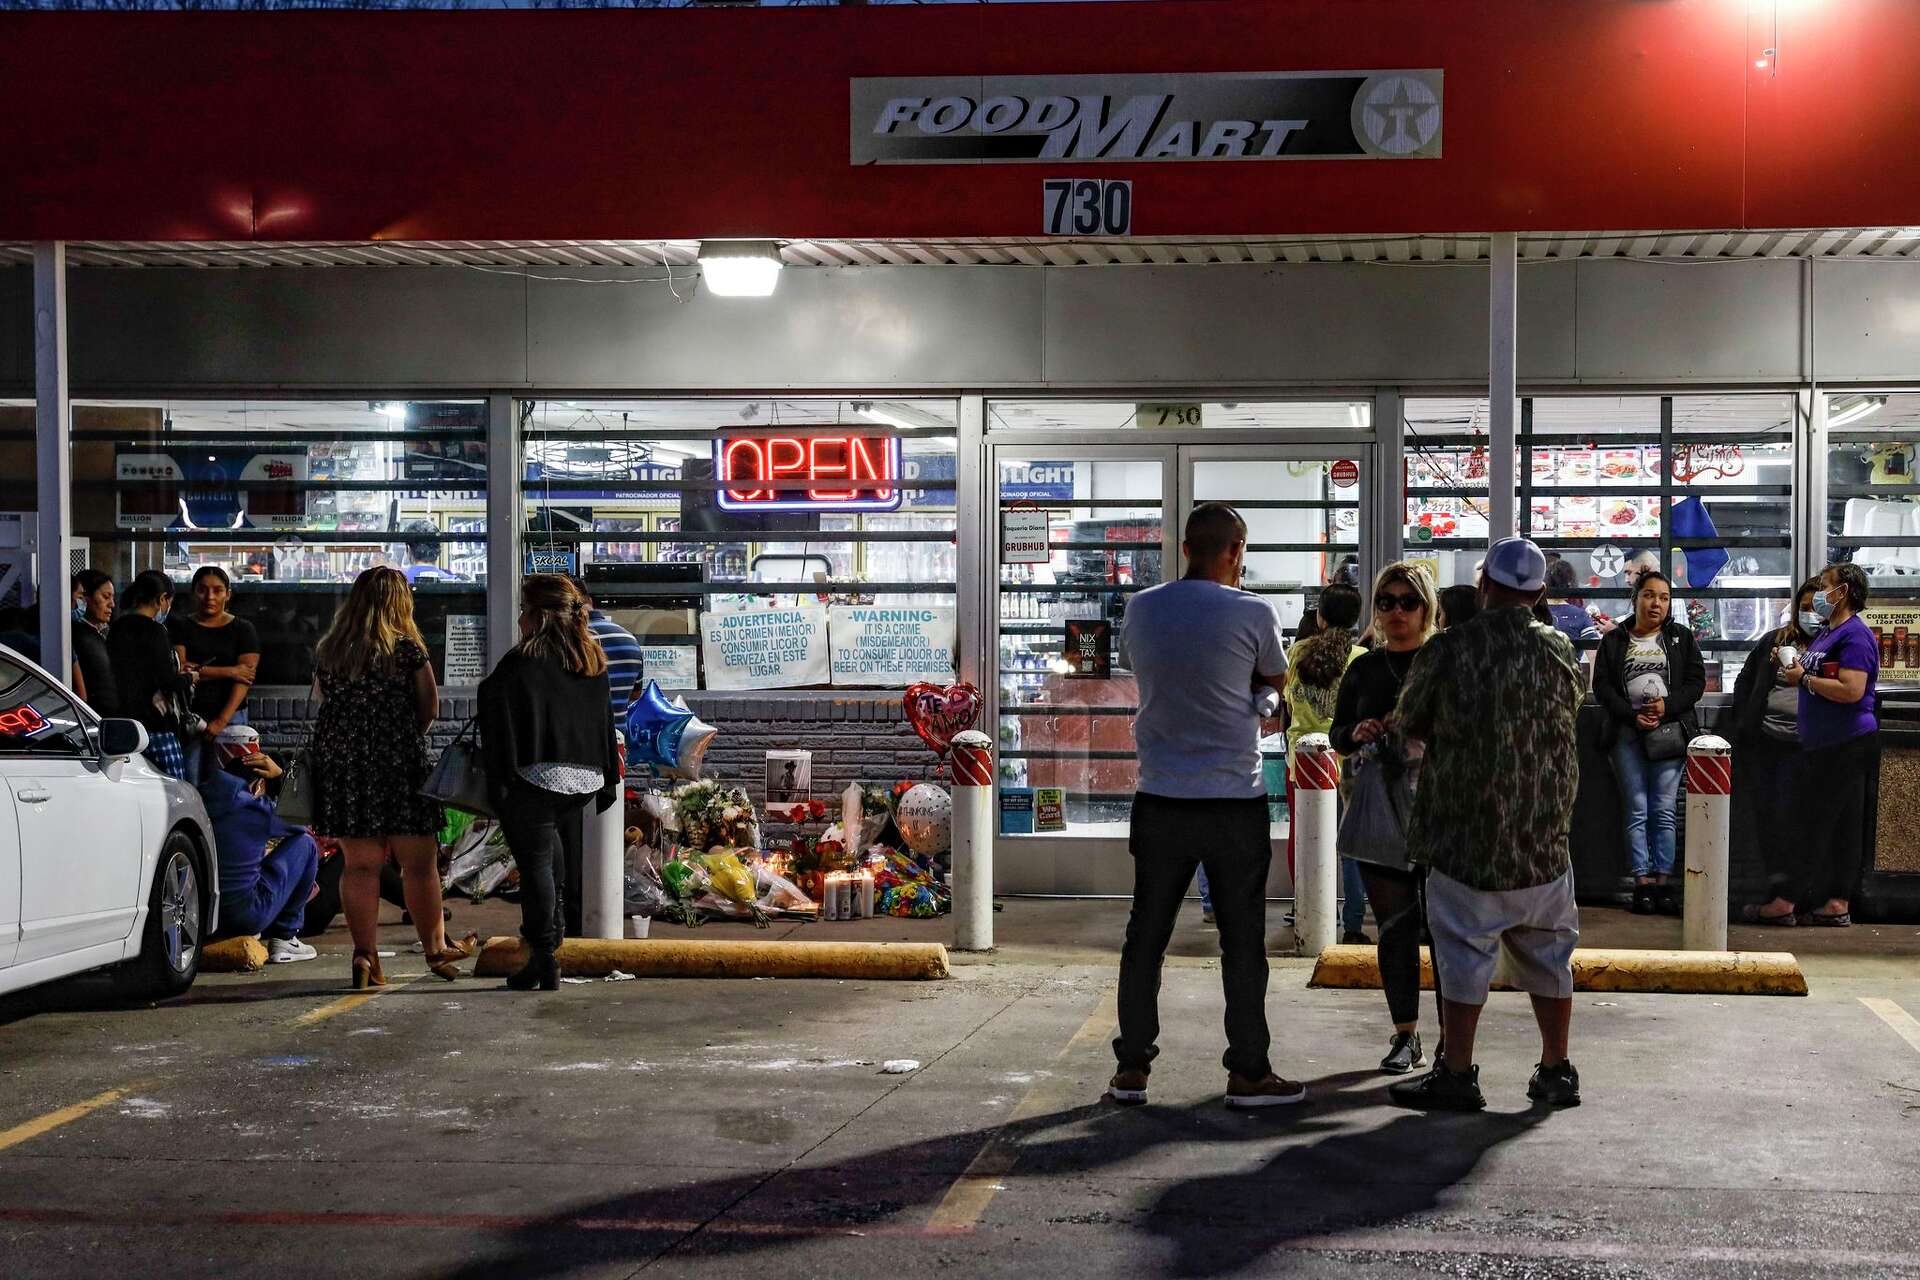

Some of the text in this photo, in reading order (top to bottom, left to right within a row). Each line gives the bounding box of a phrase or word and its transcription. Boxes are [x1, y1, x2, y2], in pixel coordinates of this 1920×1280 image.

[1045, 181, 1130, 235] 730
[1157, 407, 1201, 425] 730
[725, 437, 890, 501] OPEN
[1011, 466, 1074, 484] LIGHT
[1005, 542, 1045, 551] GRUBHUB
[534, 556, 568, 565] SKOAL
[710, 623, 816, 642] ES UN CRIMEN (MENOR)
[864, 623, 921, 635] IT IS A CRIME
[720, 636, 808, 654] CONSUMIR LICOR O
[855, 636, 930, 648] (MISDEMEANOR)
[1080, 633, 1096, 643] NIX
[724, 649, 806, 666] CERVEZA EN ESTE
[839, 648, 947, 661] TO CONSUME LIQUOR OR
[1080, 649, 1096, 657] TAX
[834, 661, 858, 673] BEER
[860, 661, 873, 672] ON
[876, 661, 904, 673] THESE
[919, 694, 942, 713] TE
[931, 709, 972, 732] AMO
